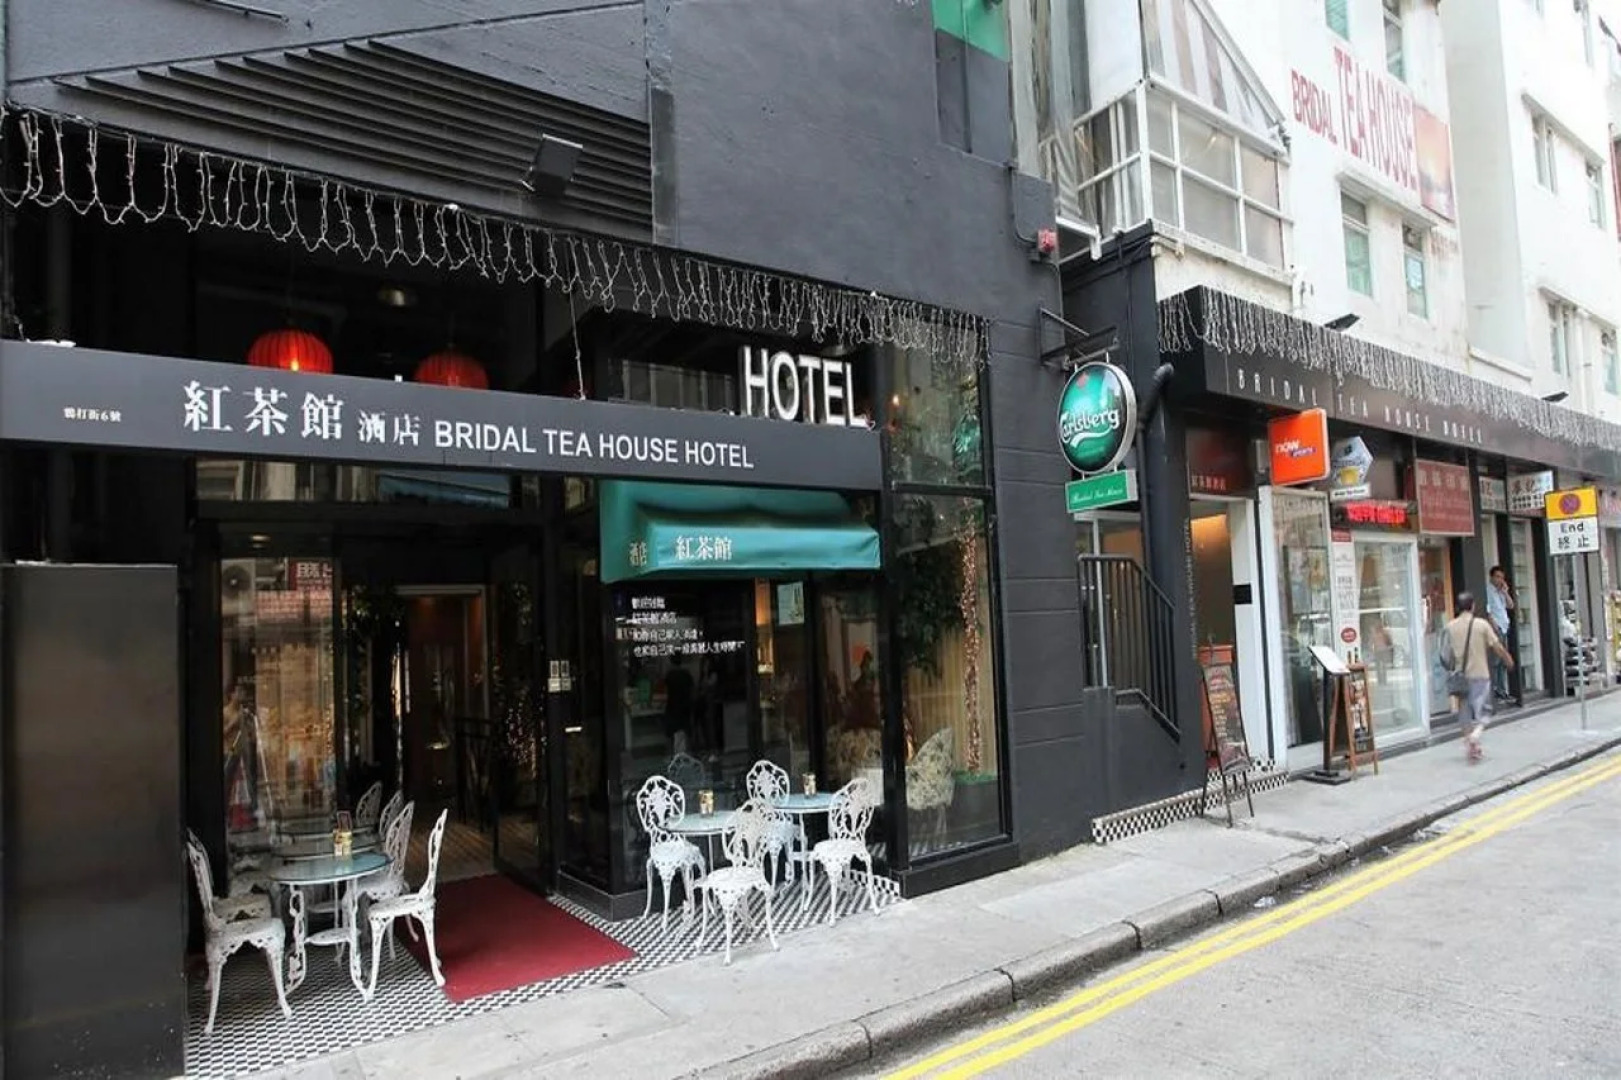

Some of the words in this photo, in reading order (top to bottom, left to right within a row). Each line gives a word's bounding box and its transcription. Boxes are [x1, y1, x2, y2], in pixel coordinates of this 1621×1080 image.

[1291, 70, 1337, 145] BRIDAL
[1334, 47, 1370, 164] TEA
[1366, 70, 1417, 190] HOUSE
[743, 346, 869, 428] HOTEL
[1238, 368, 1318, 405] BRIDAL
[183, 380, 344, 440] 紅茶館
[358, 410, 420, 446] 酒店
[1059, 409, 1120, 444] Carlsberg
[435, 420, 536, 454] BRIDAL
[543, 429, 593, 458] TEA
[599, 433, 679, 463] HOUSE
[685, 441, 754, 469] HOTEL
[1558, 534, 1590, 549] 終止
[1559, 522, 1584, 534] End
